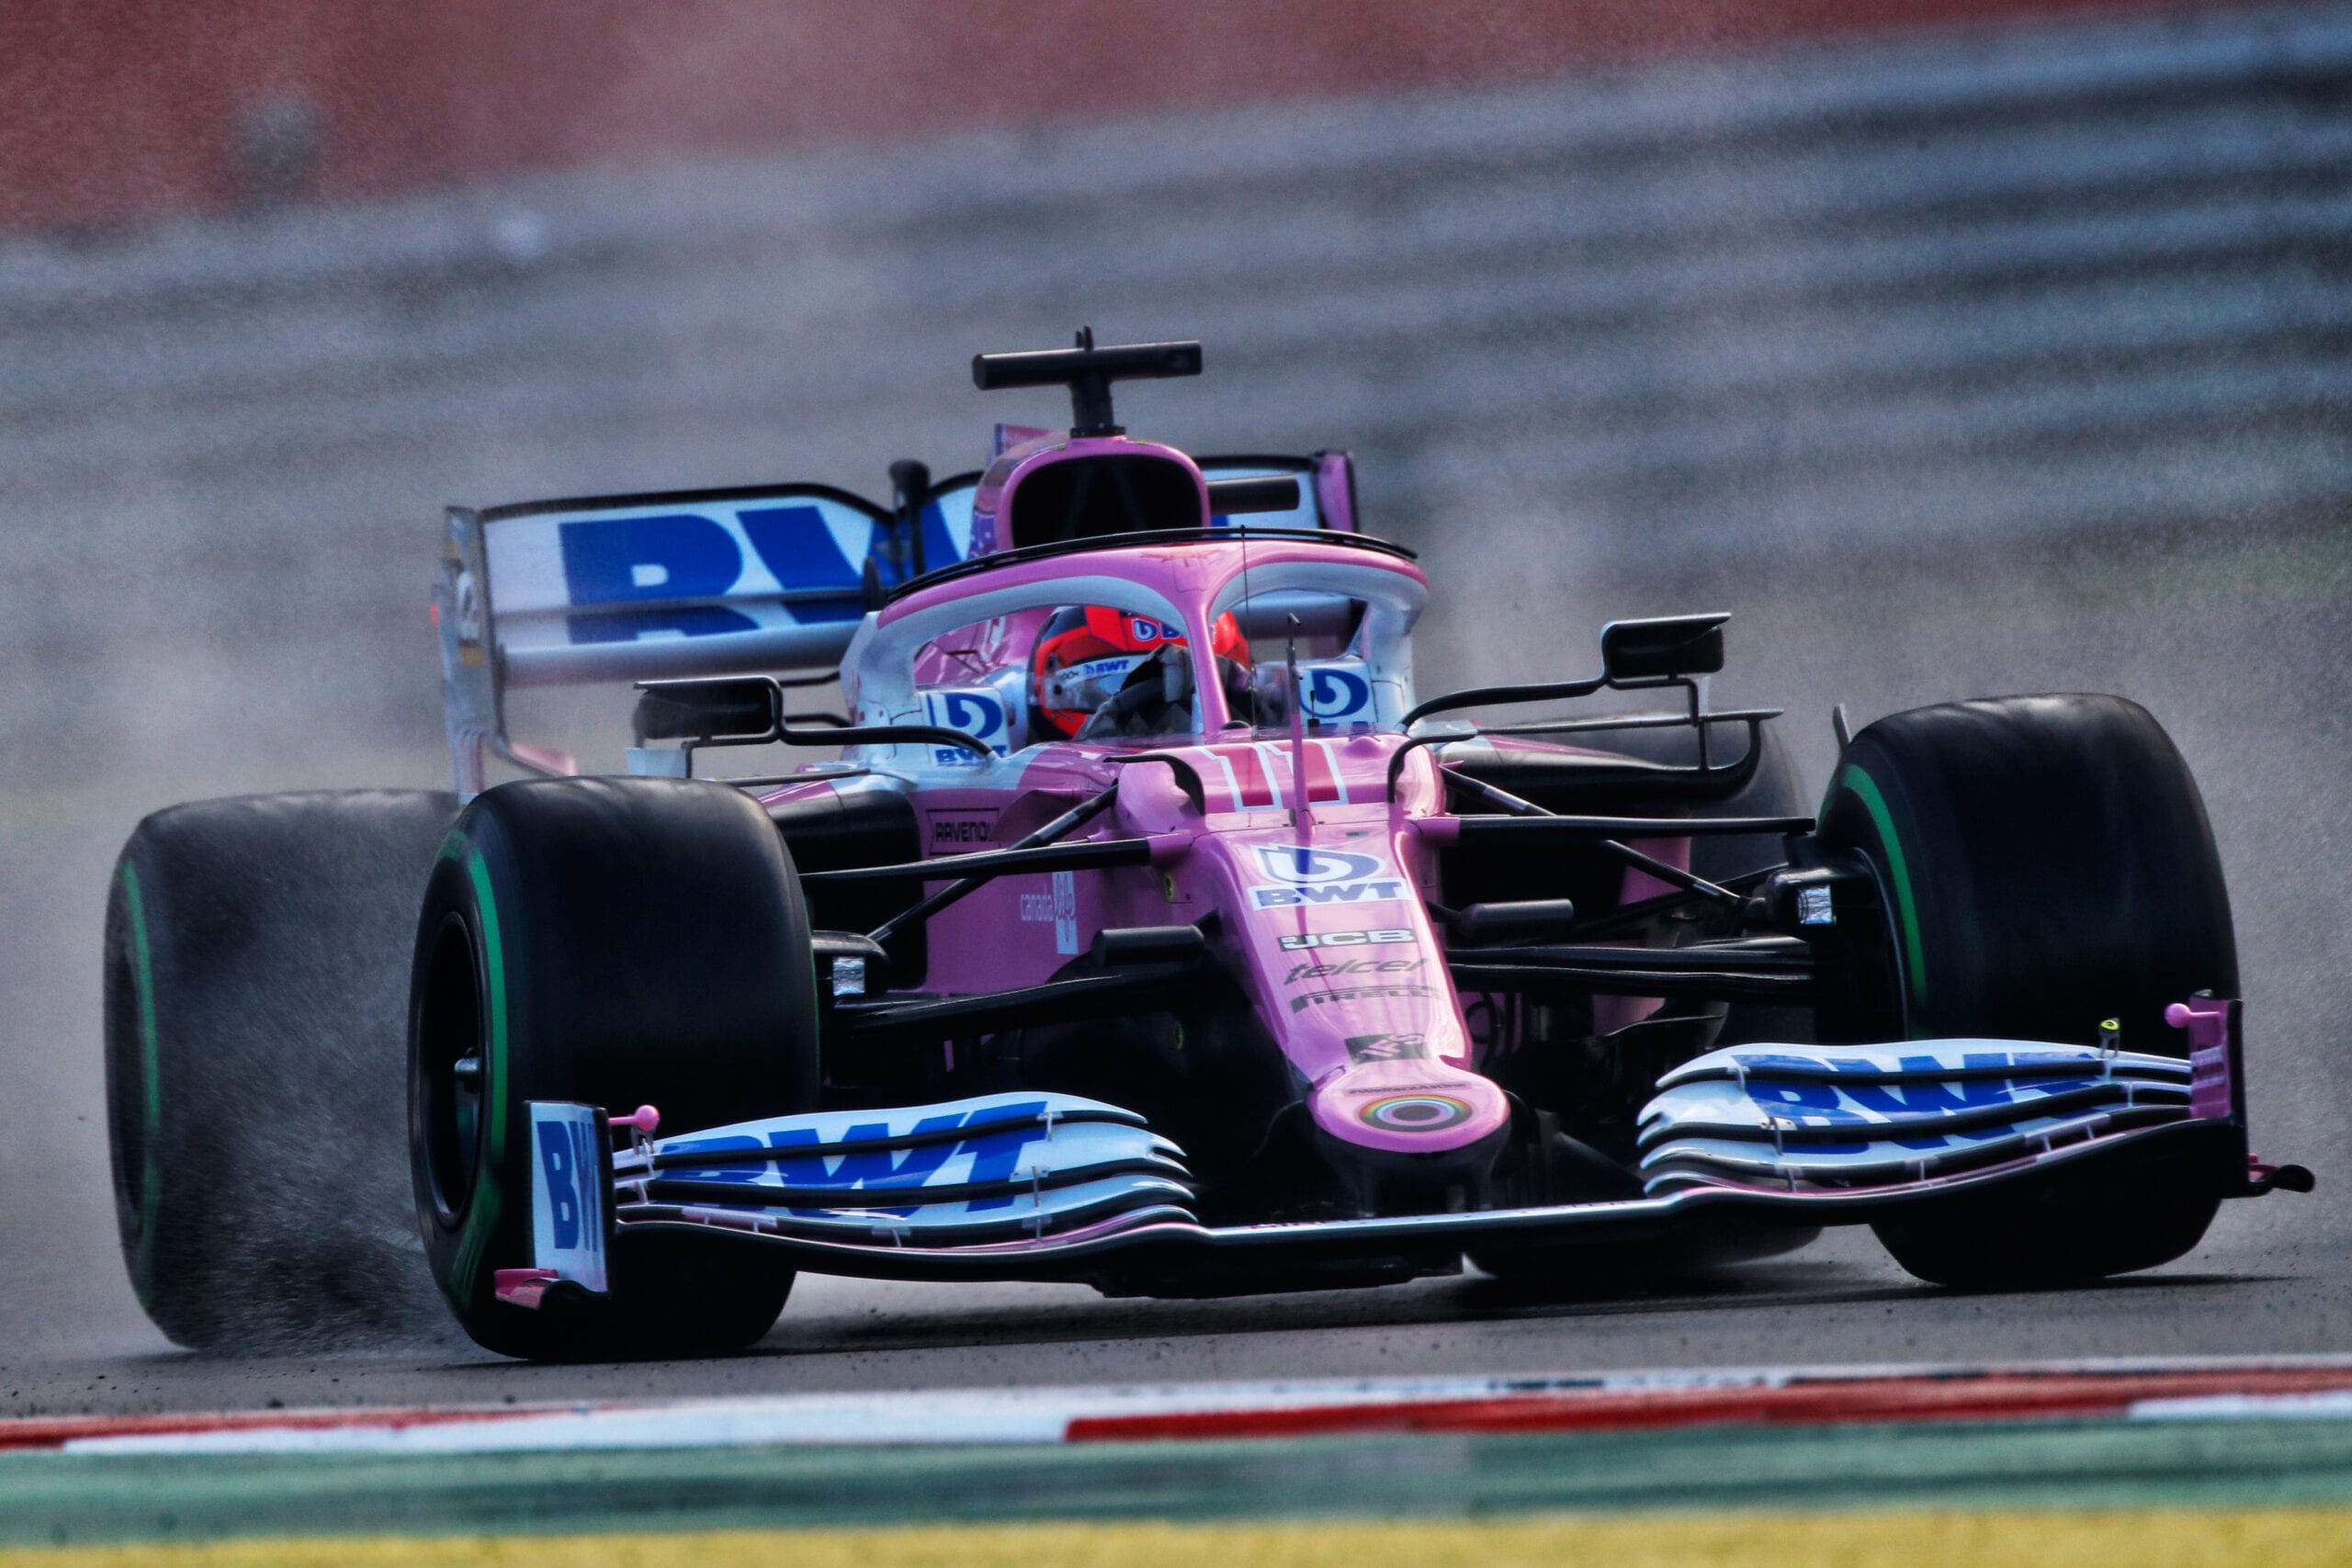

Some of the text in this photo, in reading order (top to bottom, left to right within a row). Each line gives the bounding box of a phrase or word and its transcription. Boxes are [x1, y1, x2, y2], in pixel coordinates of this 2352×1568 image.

[1255, 881, 1403, 908] BWT
[1281, 928, 1415, 950] JCB
[1283, 958, 1431, 986] telcel
[1290, 985, 1443, 1014] PIRELLI
[1731, 1052, 2102, 1154] BWT
[650, 1101, 1047, 1219] BWT
